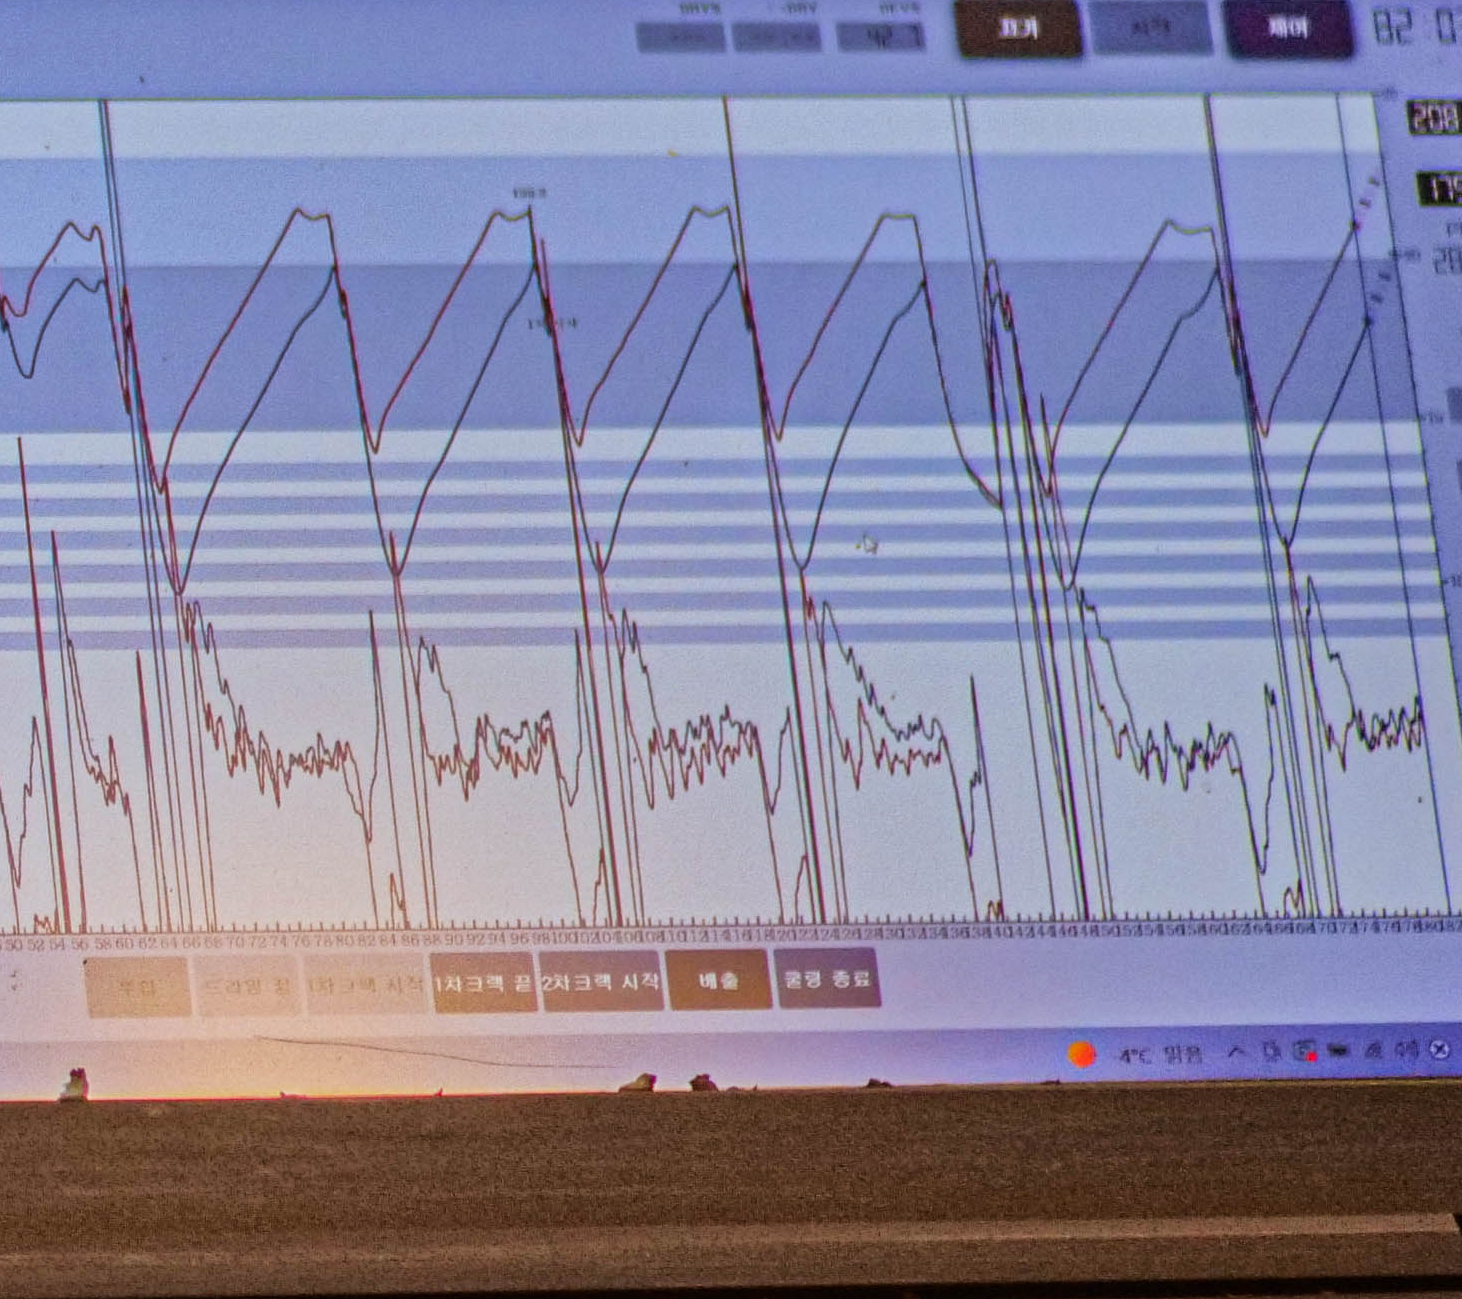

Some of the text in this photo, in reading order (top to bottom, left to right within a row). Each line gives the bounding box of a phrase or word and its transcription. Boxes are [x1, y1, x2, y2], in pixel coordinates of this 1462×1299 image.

[6, 937, 23, 950] 50
[28, 937, 45, 950] 52
[50, 936, 66, 949] 54
[71, 936, 88, 949] 56
[94, 936, 112, 949] 58
[116, 936, 134, 949] 60
[138, 935, 156, 948] 62
[622, 972, 659, 991] 시작
[699, 971, 738, 990] 배출
